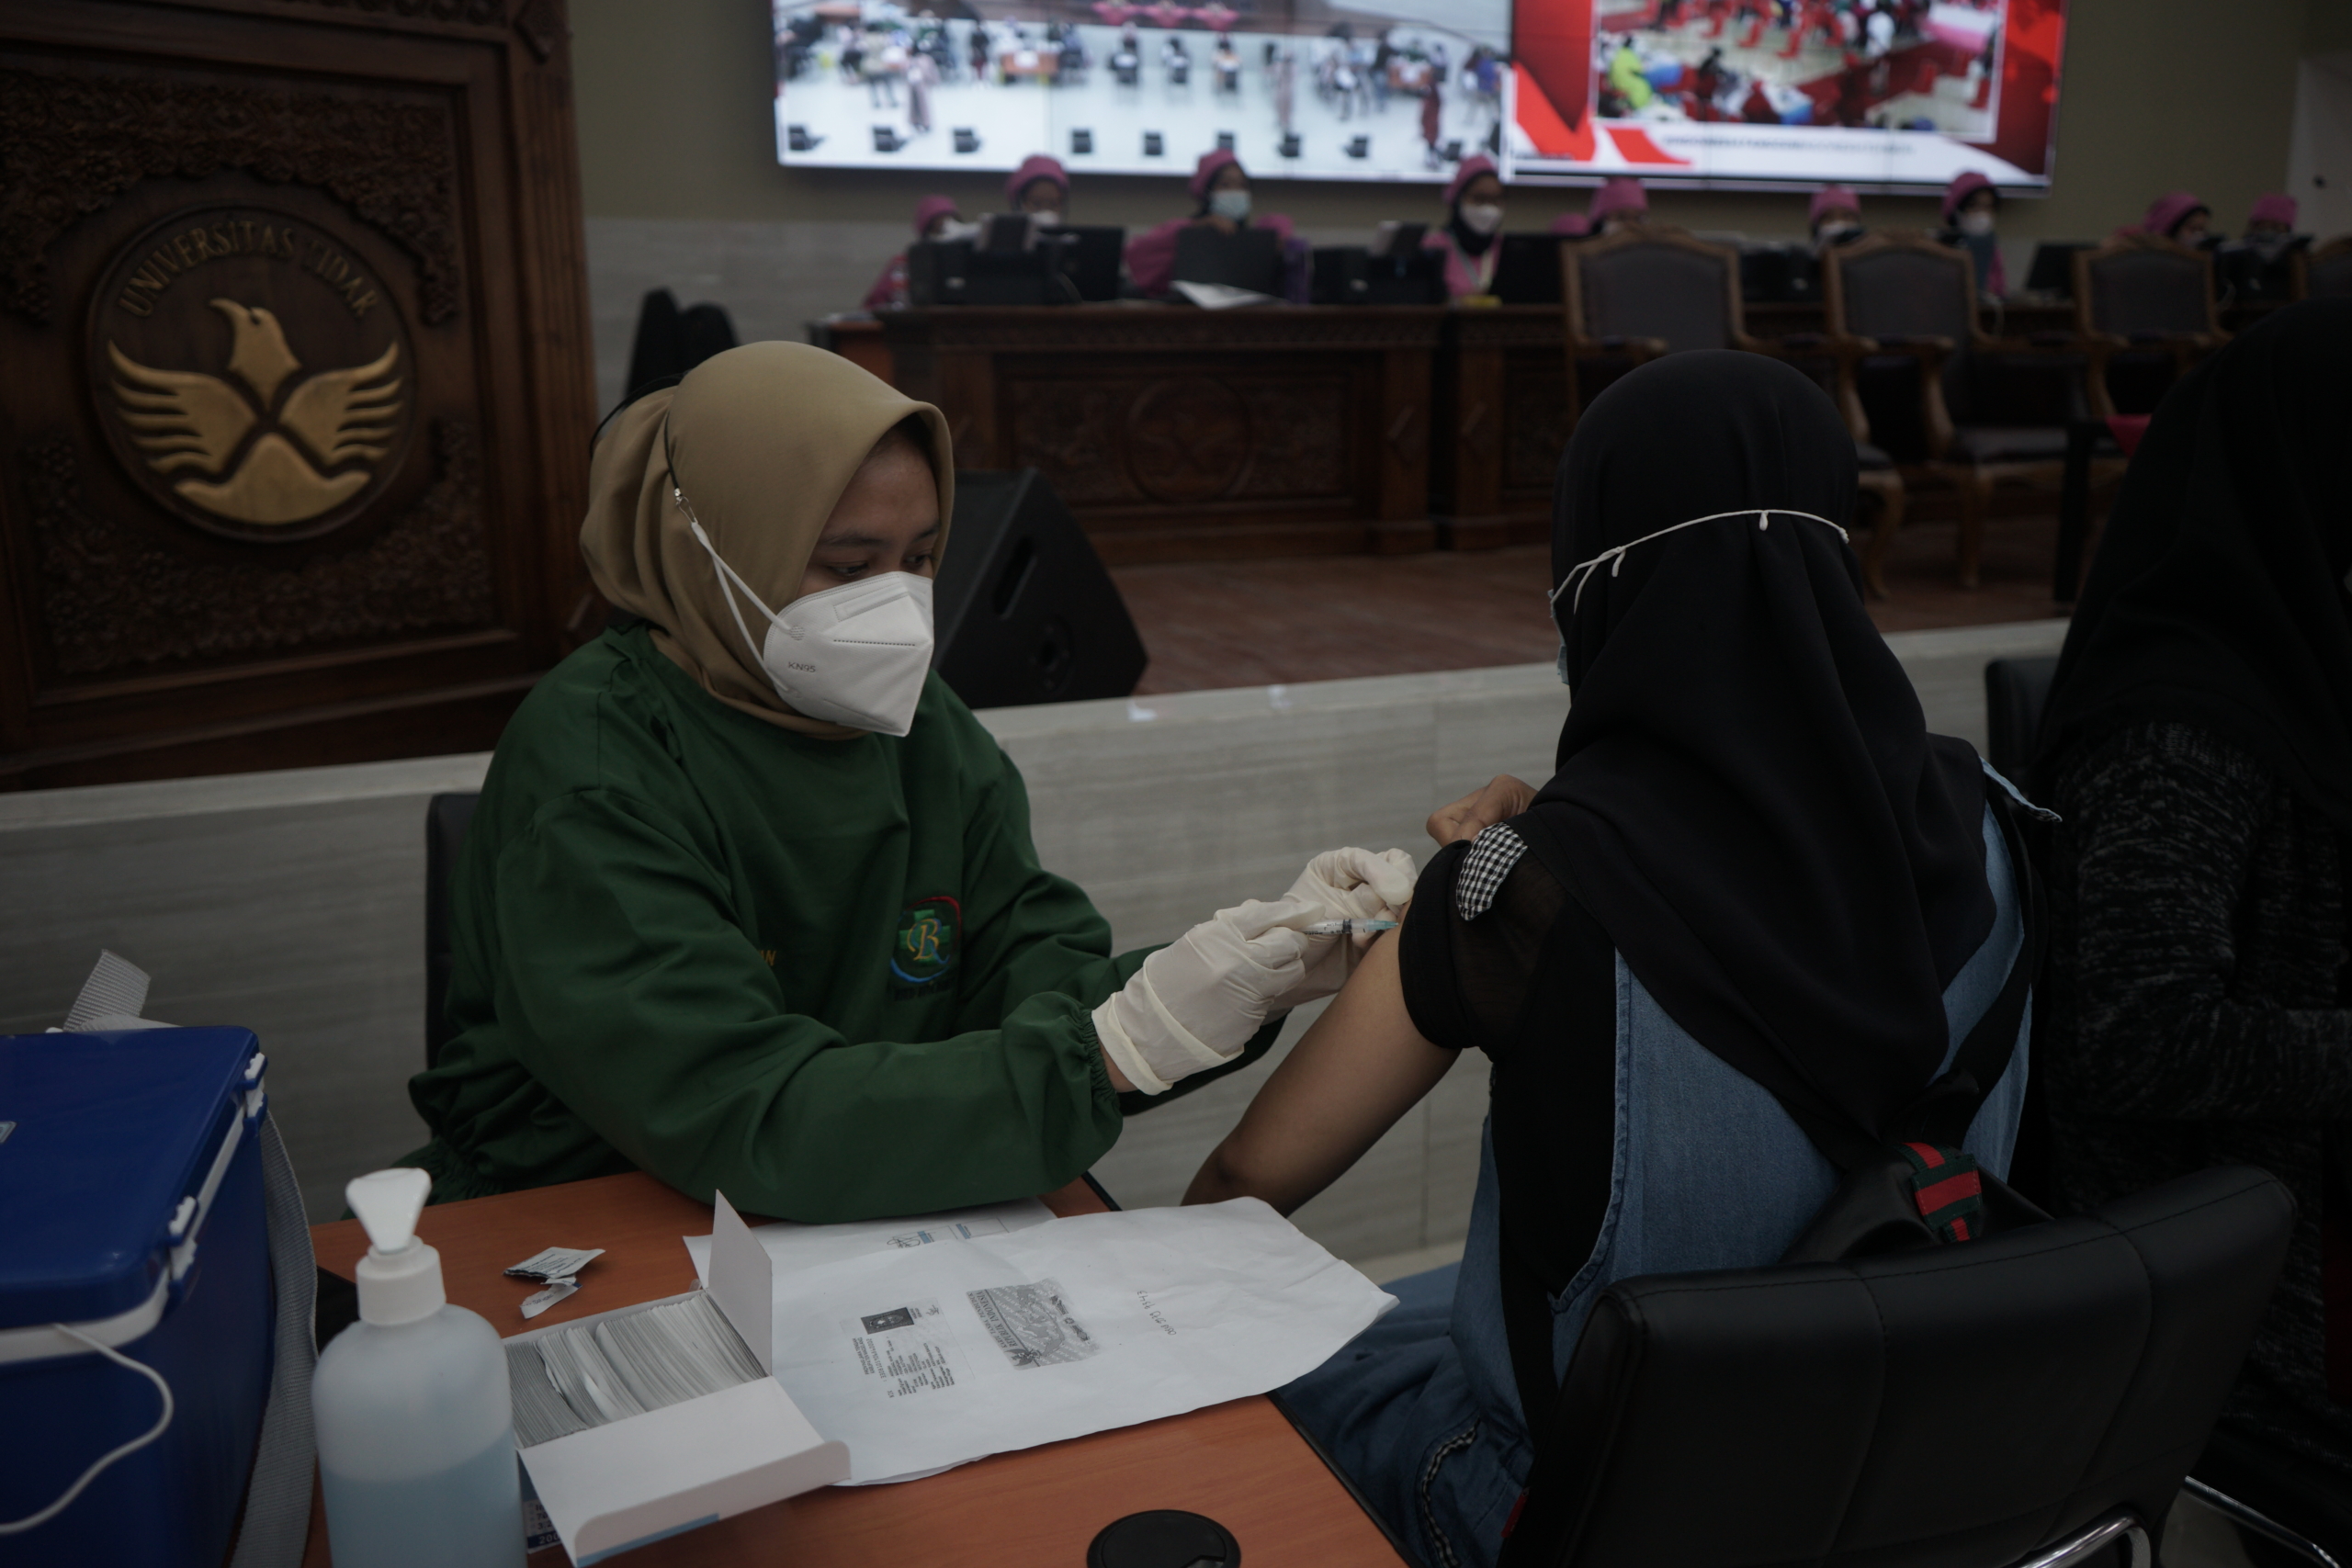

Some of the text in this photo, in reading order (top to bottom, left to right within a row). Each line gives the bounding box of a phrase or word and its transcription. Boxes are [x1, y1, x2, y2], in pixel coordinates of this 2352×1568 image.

[119, 220, 378, 318] UNIVERSITAS TIDAR
[788, 661, 816, 672] KN95
[976, 1292, 1000, 1322] INDONESIA
